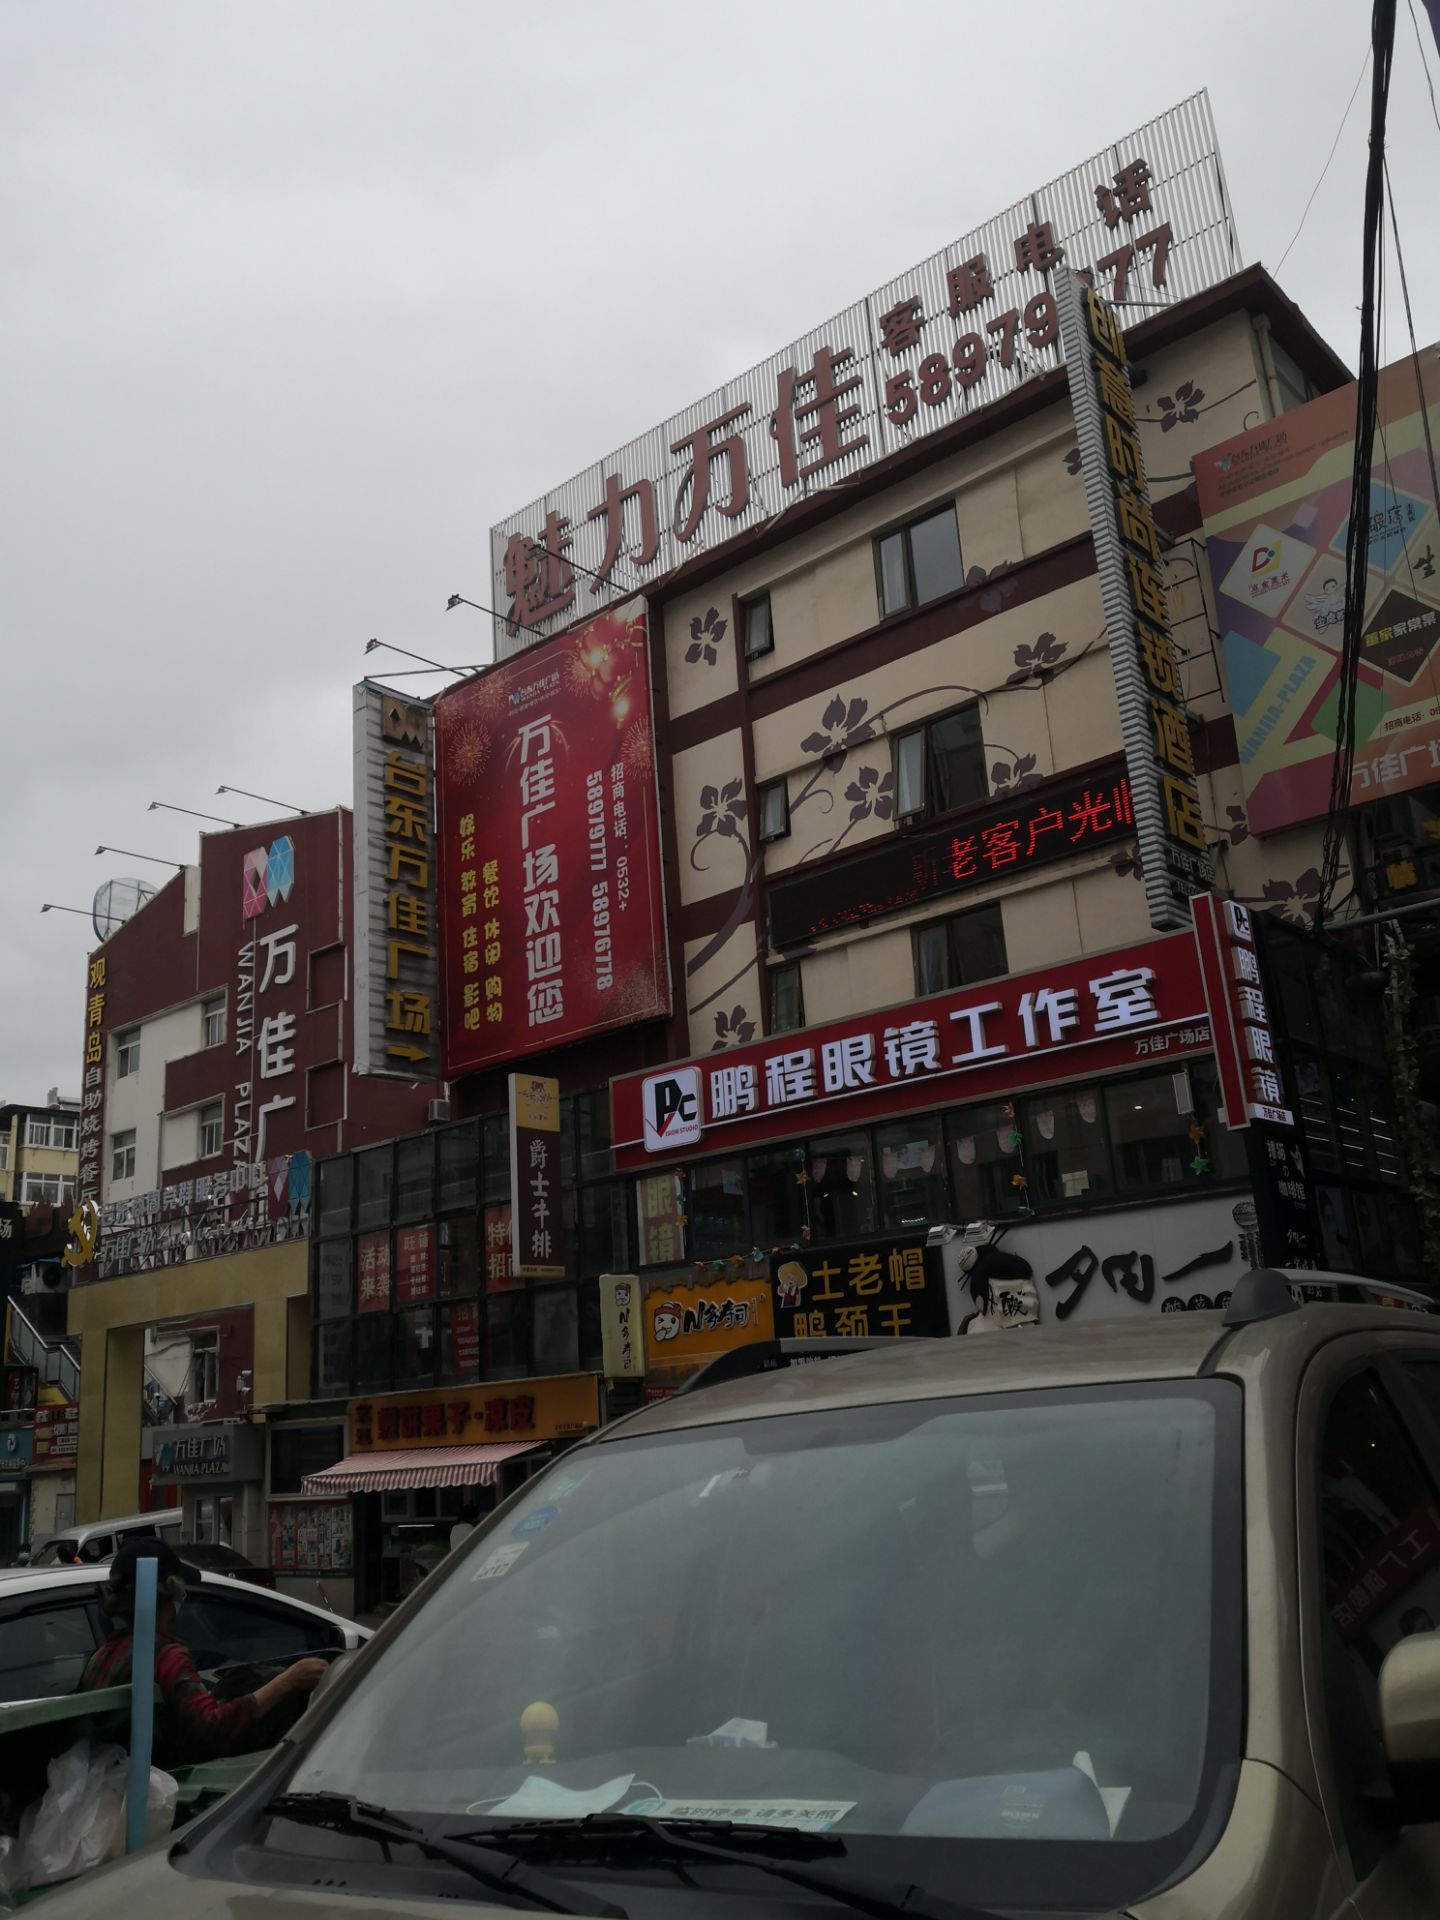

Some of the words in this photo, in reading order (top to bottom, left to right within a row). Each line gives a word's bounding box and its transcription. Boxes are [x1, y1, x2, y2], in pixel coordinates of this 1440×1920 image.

[879, 158, 1153, 357] 客服电话
[886, 222, 1173, 426] 5897977
[504, 346, 868, 637] 魅力万佳
[1085, 286, 1206, 852] 创意时尚连锁酒店
[459, 813, 475, 862] 娱乐
[587, 770, 607, 872] 58979777
[385, 751, 431, 1036] 台东万佳广场
[460, 871, 477, 918] 教育
[482, 860, 500, 911] 餐饮
[518, 713, 566, 1028] 万佳广场欢迎您
[462, 928, 479, 974] 住宿
[484, 919, 501, 966] 休闲
[592, 882, 614, 989] 58976778
[235, 941, 254, 1057] WANJIA
[464, 984, 480, 1031] 影吧
[486, 975, 503, 1024] 购物
[1232, 946, 1281, 1105] 鹏程眼镜
[710, 966, 1161, 1118] 鹏程眼镜工作室
[1134, 1024, 1212, 1056] 万佳广场店
[528, 1139, 553, 1260] 爵士牛排
[360, 1243, 390, 1272] 活动
[360, 1274, 391, 1300] 来袭
[811, 1247, 927, 1304] 土老帽
[175, 1435, 226, 1459] 万佳广场
